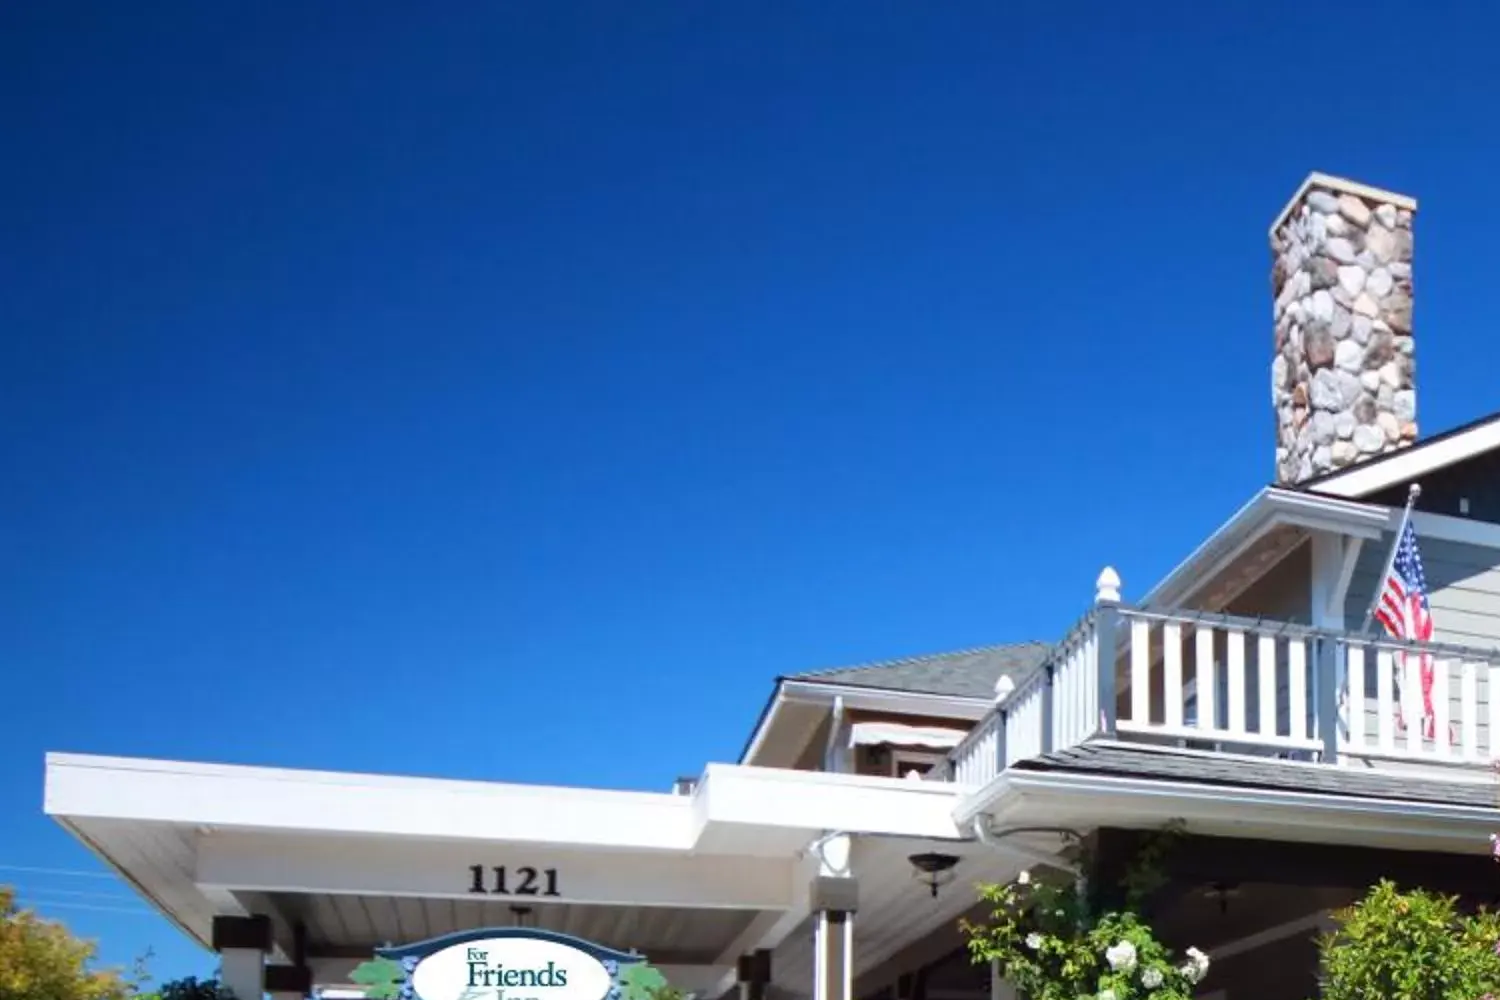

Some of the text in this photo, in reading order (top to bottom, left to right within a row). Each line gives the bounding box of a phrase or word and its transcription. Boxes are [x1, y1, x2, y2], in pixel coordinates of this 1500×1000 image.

[468, 864, 561, 896] 1121
[466, 947, 489, 960] For
[466, 961, 567, 987] Friends
